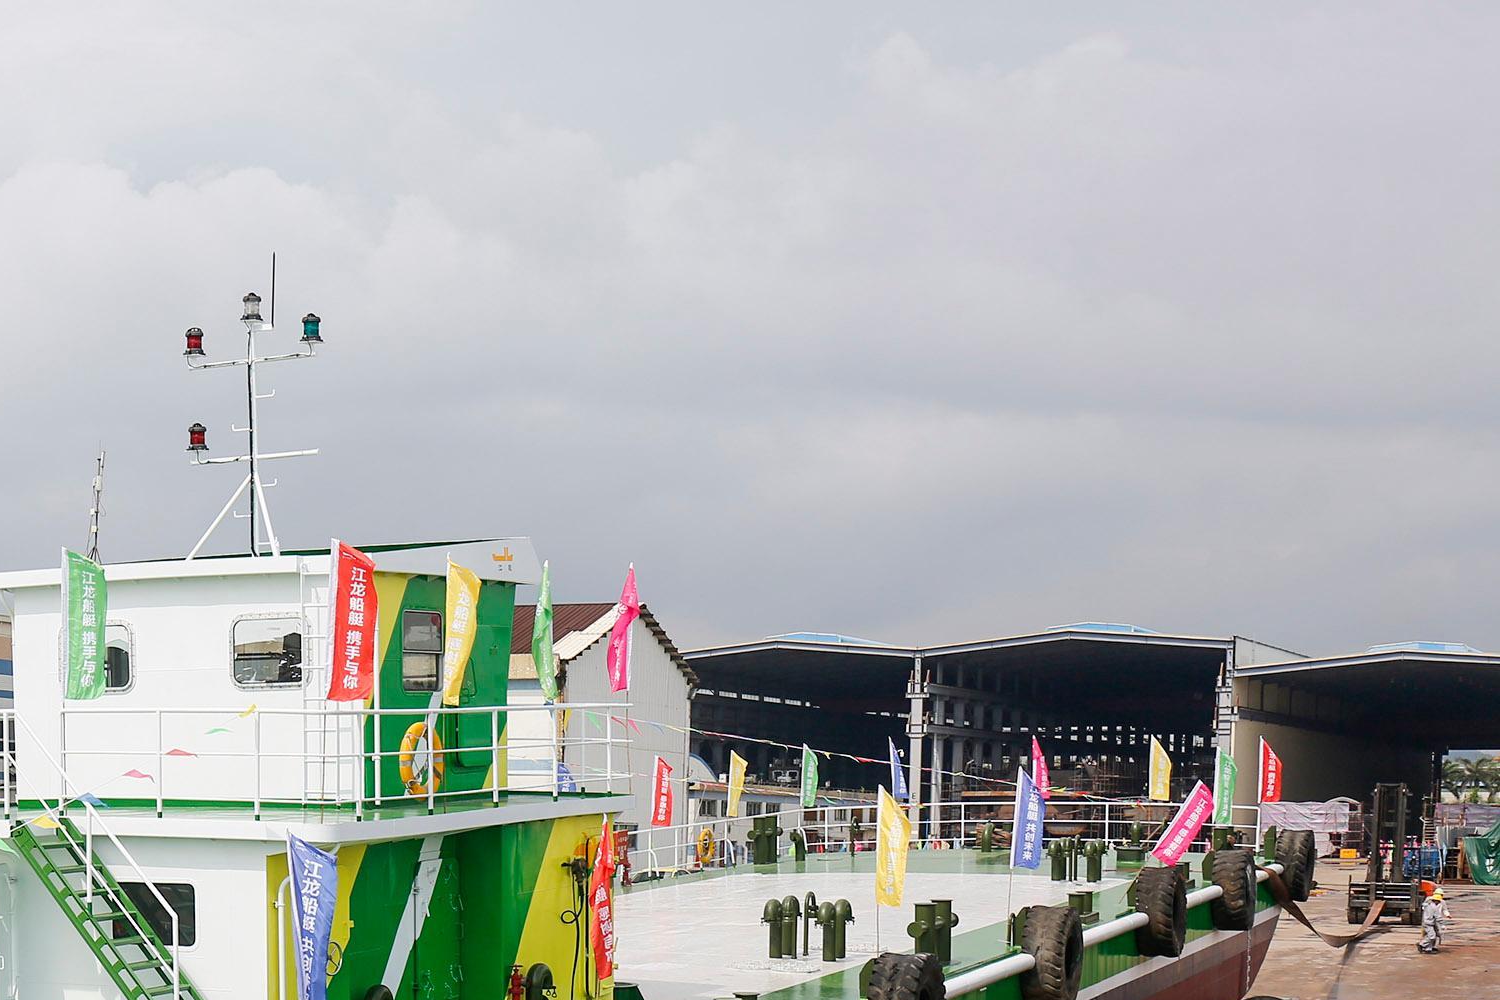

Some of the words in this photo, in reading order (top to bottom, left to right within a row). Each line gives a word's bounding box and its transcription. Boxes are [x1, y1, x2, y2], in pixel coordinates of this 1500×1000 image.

[82, 571, 97, 627] 江龙船艇
[347, 566, 367, 627] 江龙船艇
[452, 583, 470, 634] 龙船艇
[80, 631, 97, 688] 携手与你
[343, 630, 363, 689] 携手与你
[300, 859, 324, 934] 江龙船艇
